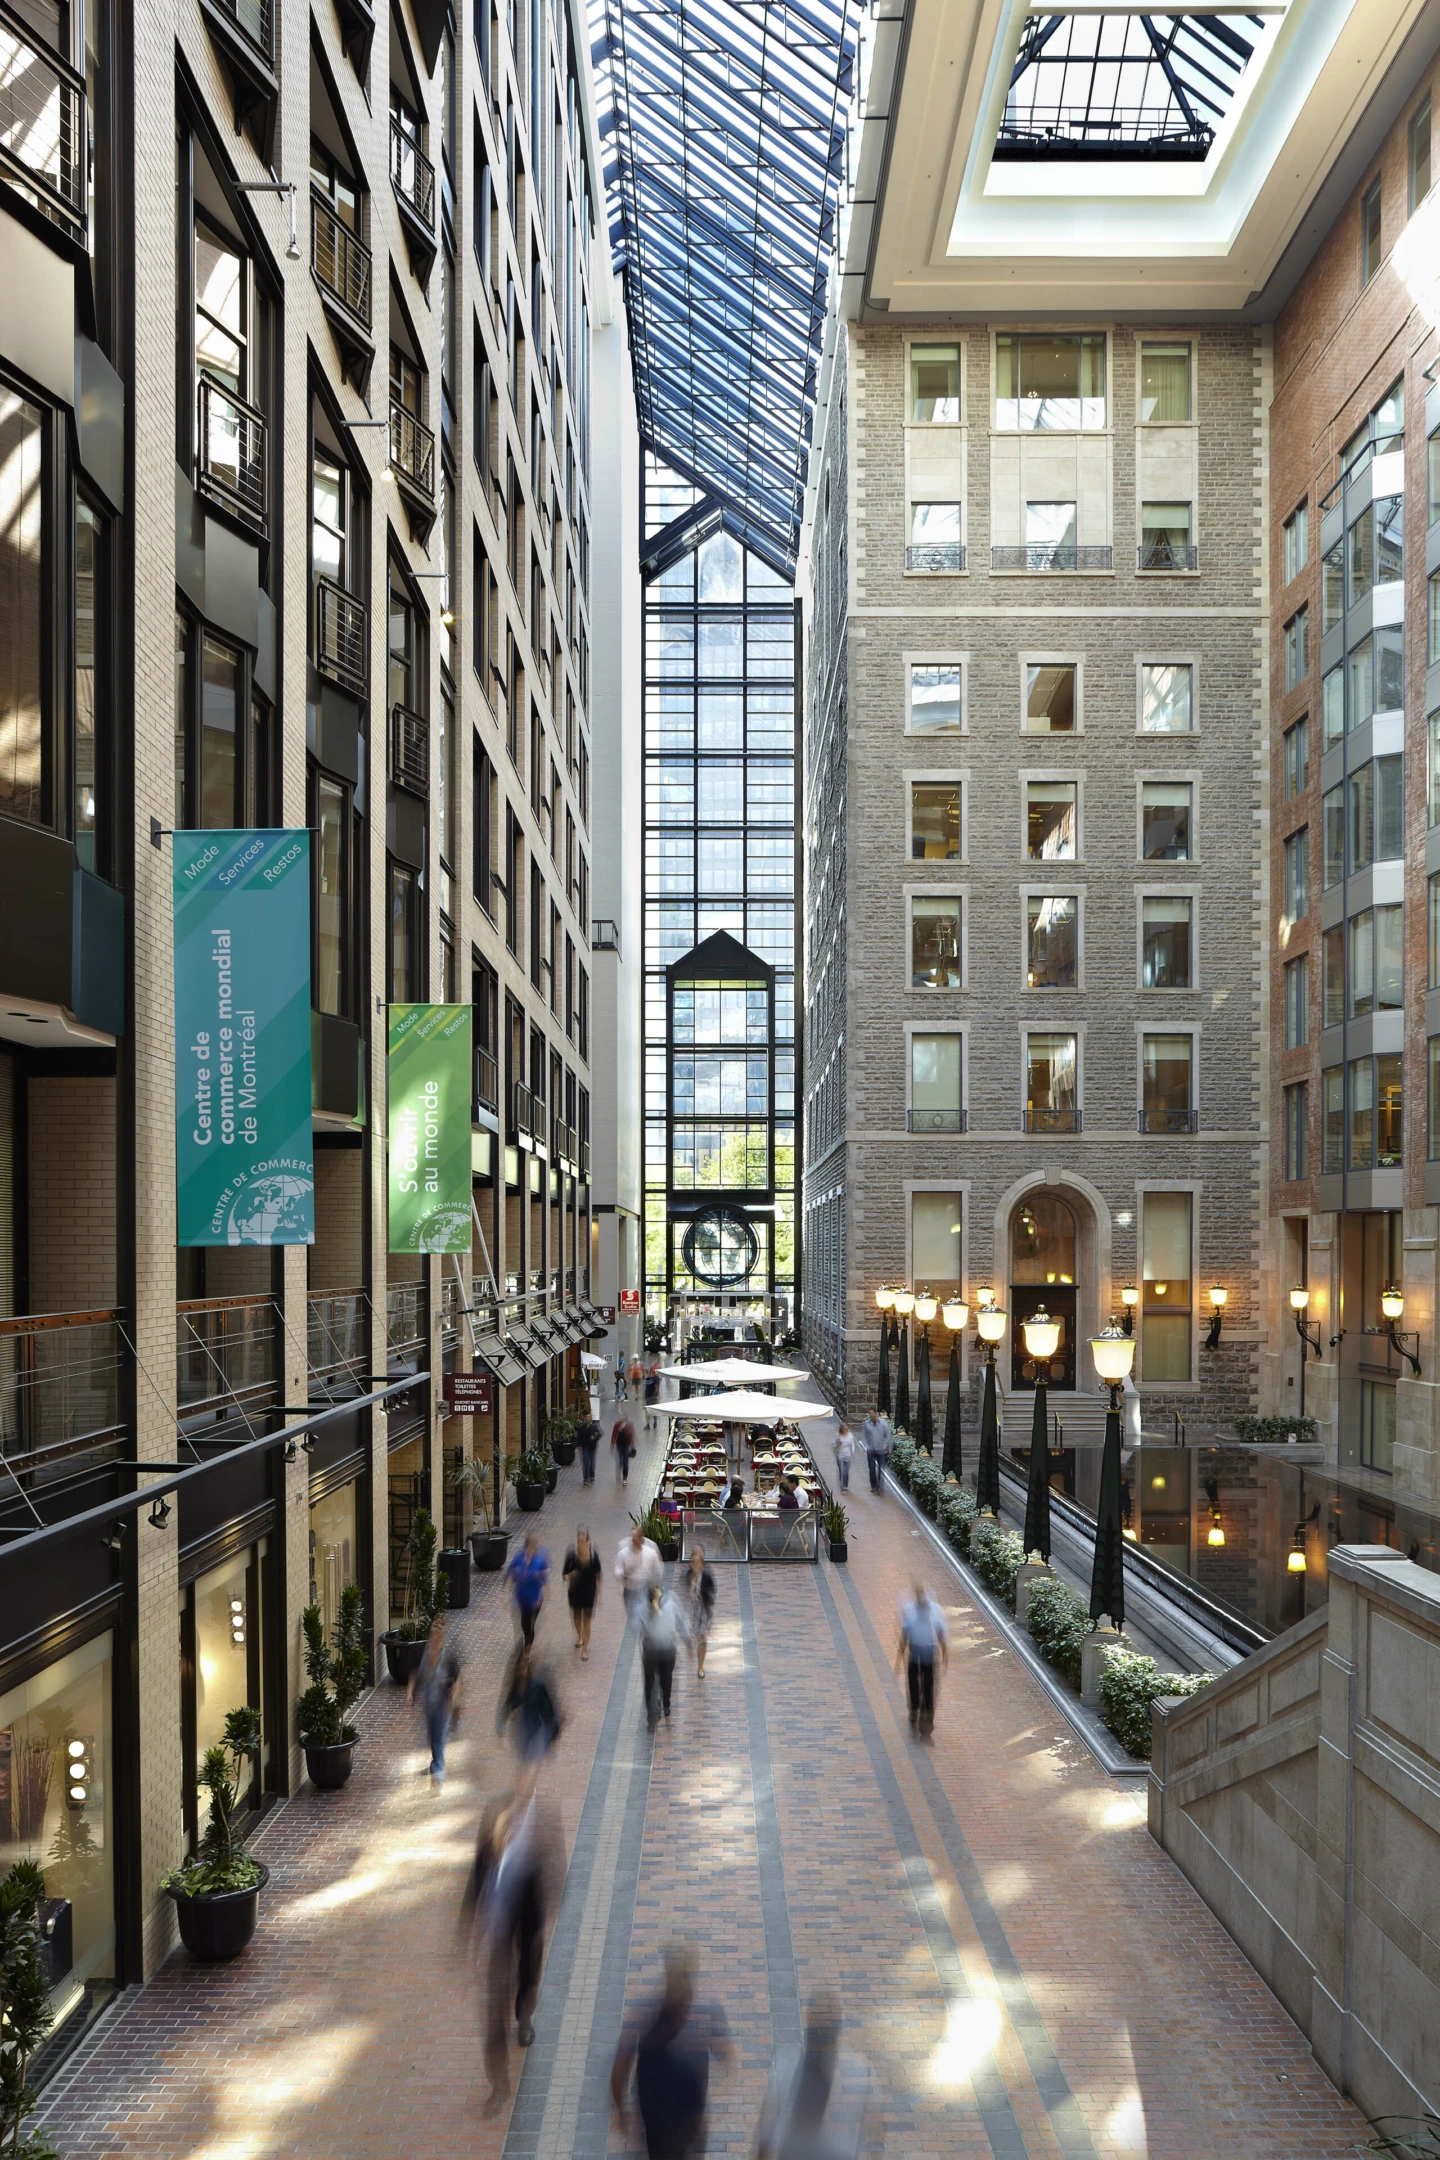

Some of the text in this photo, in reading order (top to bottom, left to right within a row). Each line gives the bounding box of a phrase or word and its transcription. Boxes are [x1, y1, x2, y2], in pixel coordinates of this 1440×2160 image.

[184, 845, 219, 880] Mode
[218, 839, 265, 885] Services
[262, 844, 302, 882] Restos
[211, 929, 235, 1145] commerce mondial
[396, 1013, 419, 1034] Mode
[417, 1009, 446, 1038] Services
[443, 1013, 468, 1036] Restos
[190, 1031, 212, 1145] Centre de
[236, 1010, 258, 1145] de Montréal
[398, 1106, 419, 1193] S'ouvrir
[418, 1081, 439, 1193] au monde
[211, 1159, 314, 1233] CENTRE DE COMMERC
[408, 1218, 424, 1247] CENTRE
[422, 1209, 432, 1219] DE
